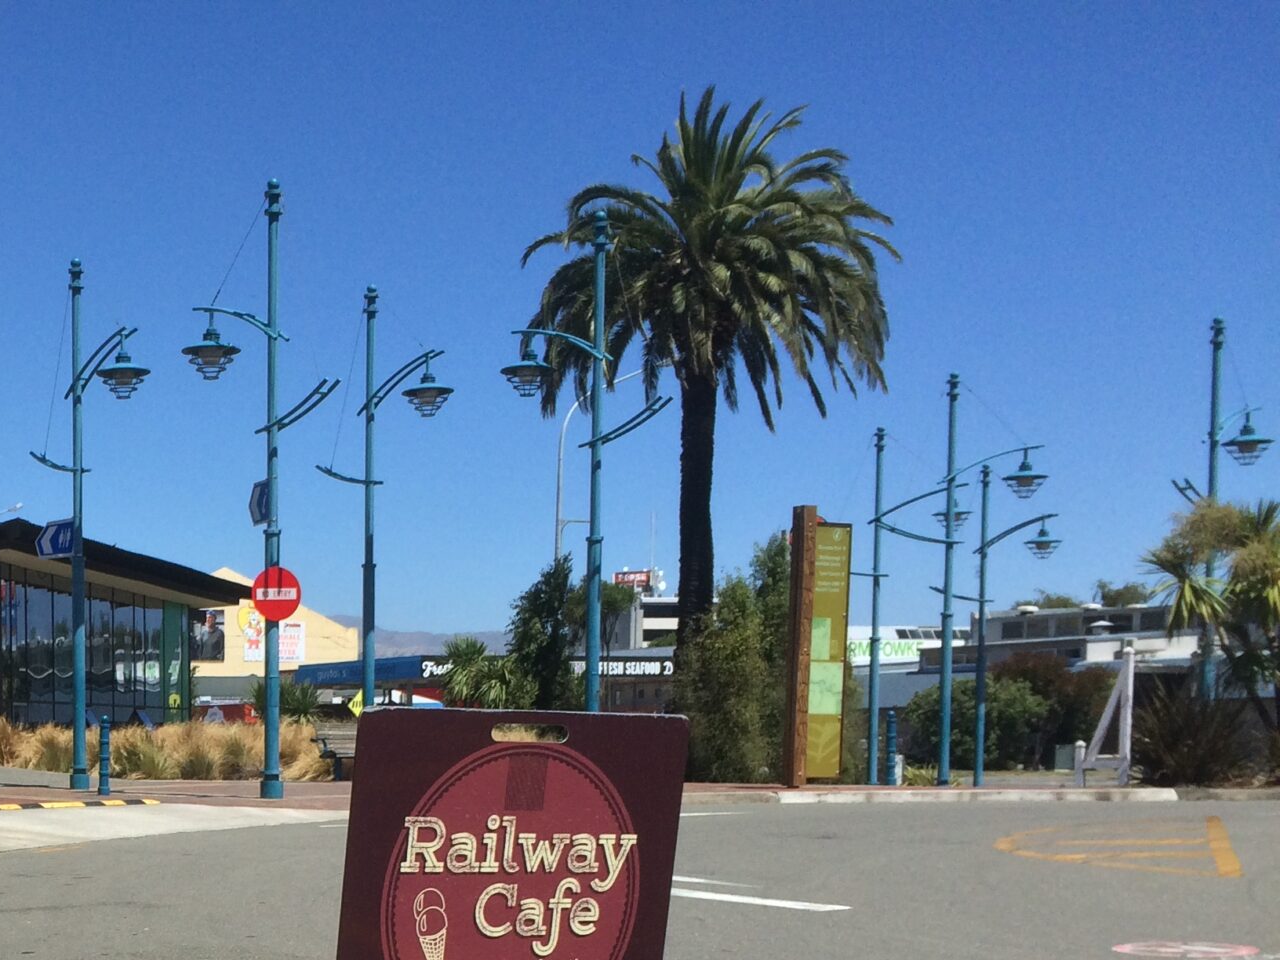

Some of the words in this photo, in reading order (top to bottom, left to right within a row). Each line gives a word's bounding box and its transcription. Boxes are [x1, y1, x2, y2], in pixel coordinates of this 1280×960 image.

[625, 661, 661, 675] SEAFOOD
[400, 815, 638, 894] Railway
[475, 878, 601, 956] Cafe
